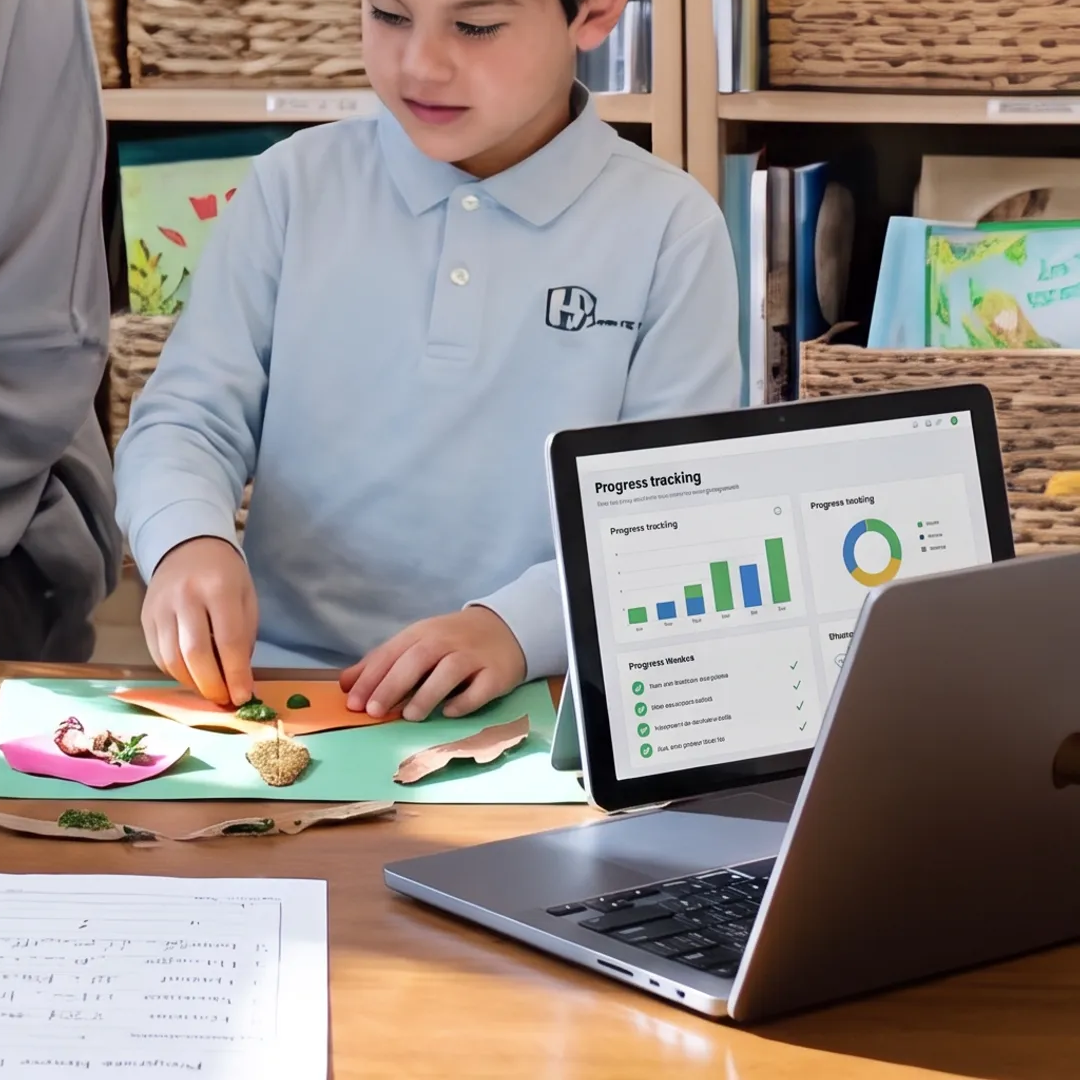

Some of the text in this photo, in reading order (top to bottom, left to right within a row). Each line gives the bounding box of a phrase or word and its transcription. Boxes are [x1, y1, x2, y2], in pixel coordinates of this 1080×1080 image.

[595, 471, 702, 494] Progress tracking
[810, 499, 845, 510] Progress
